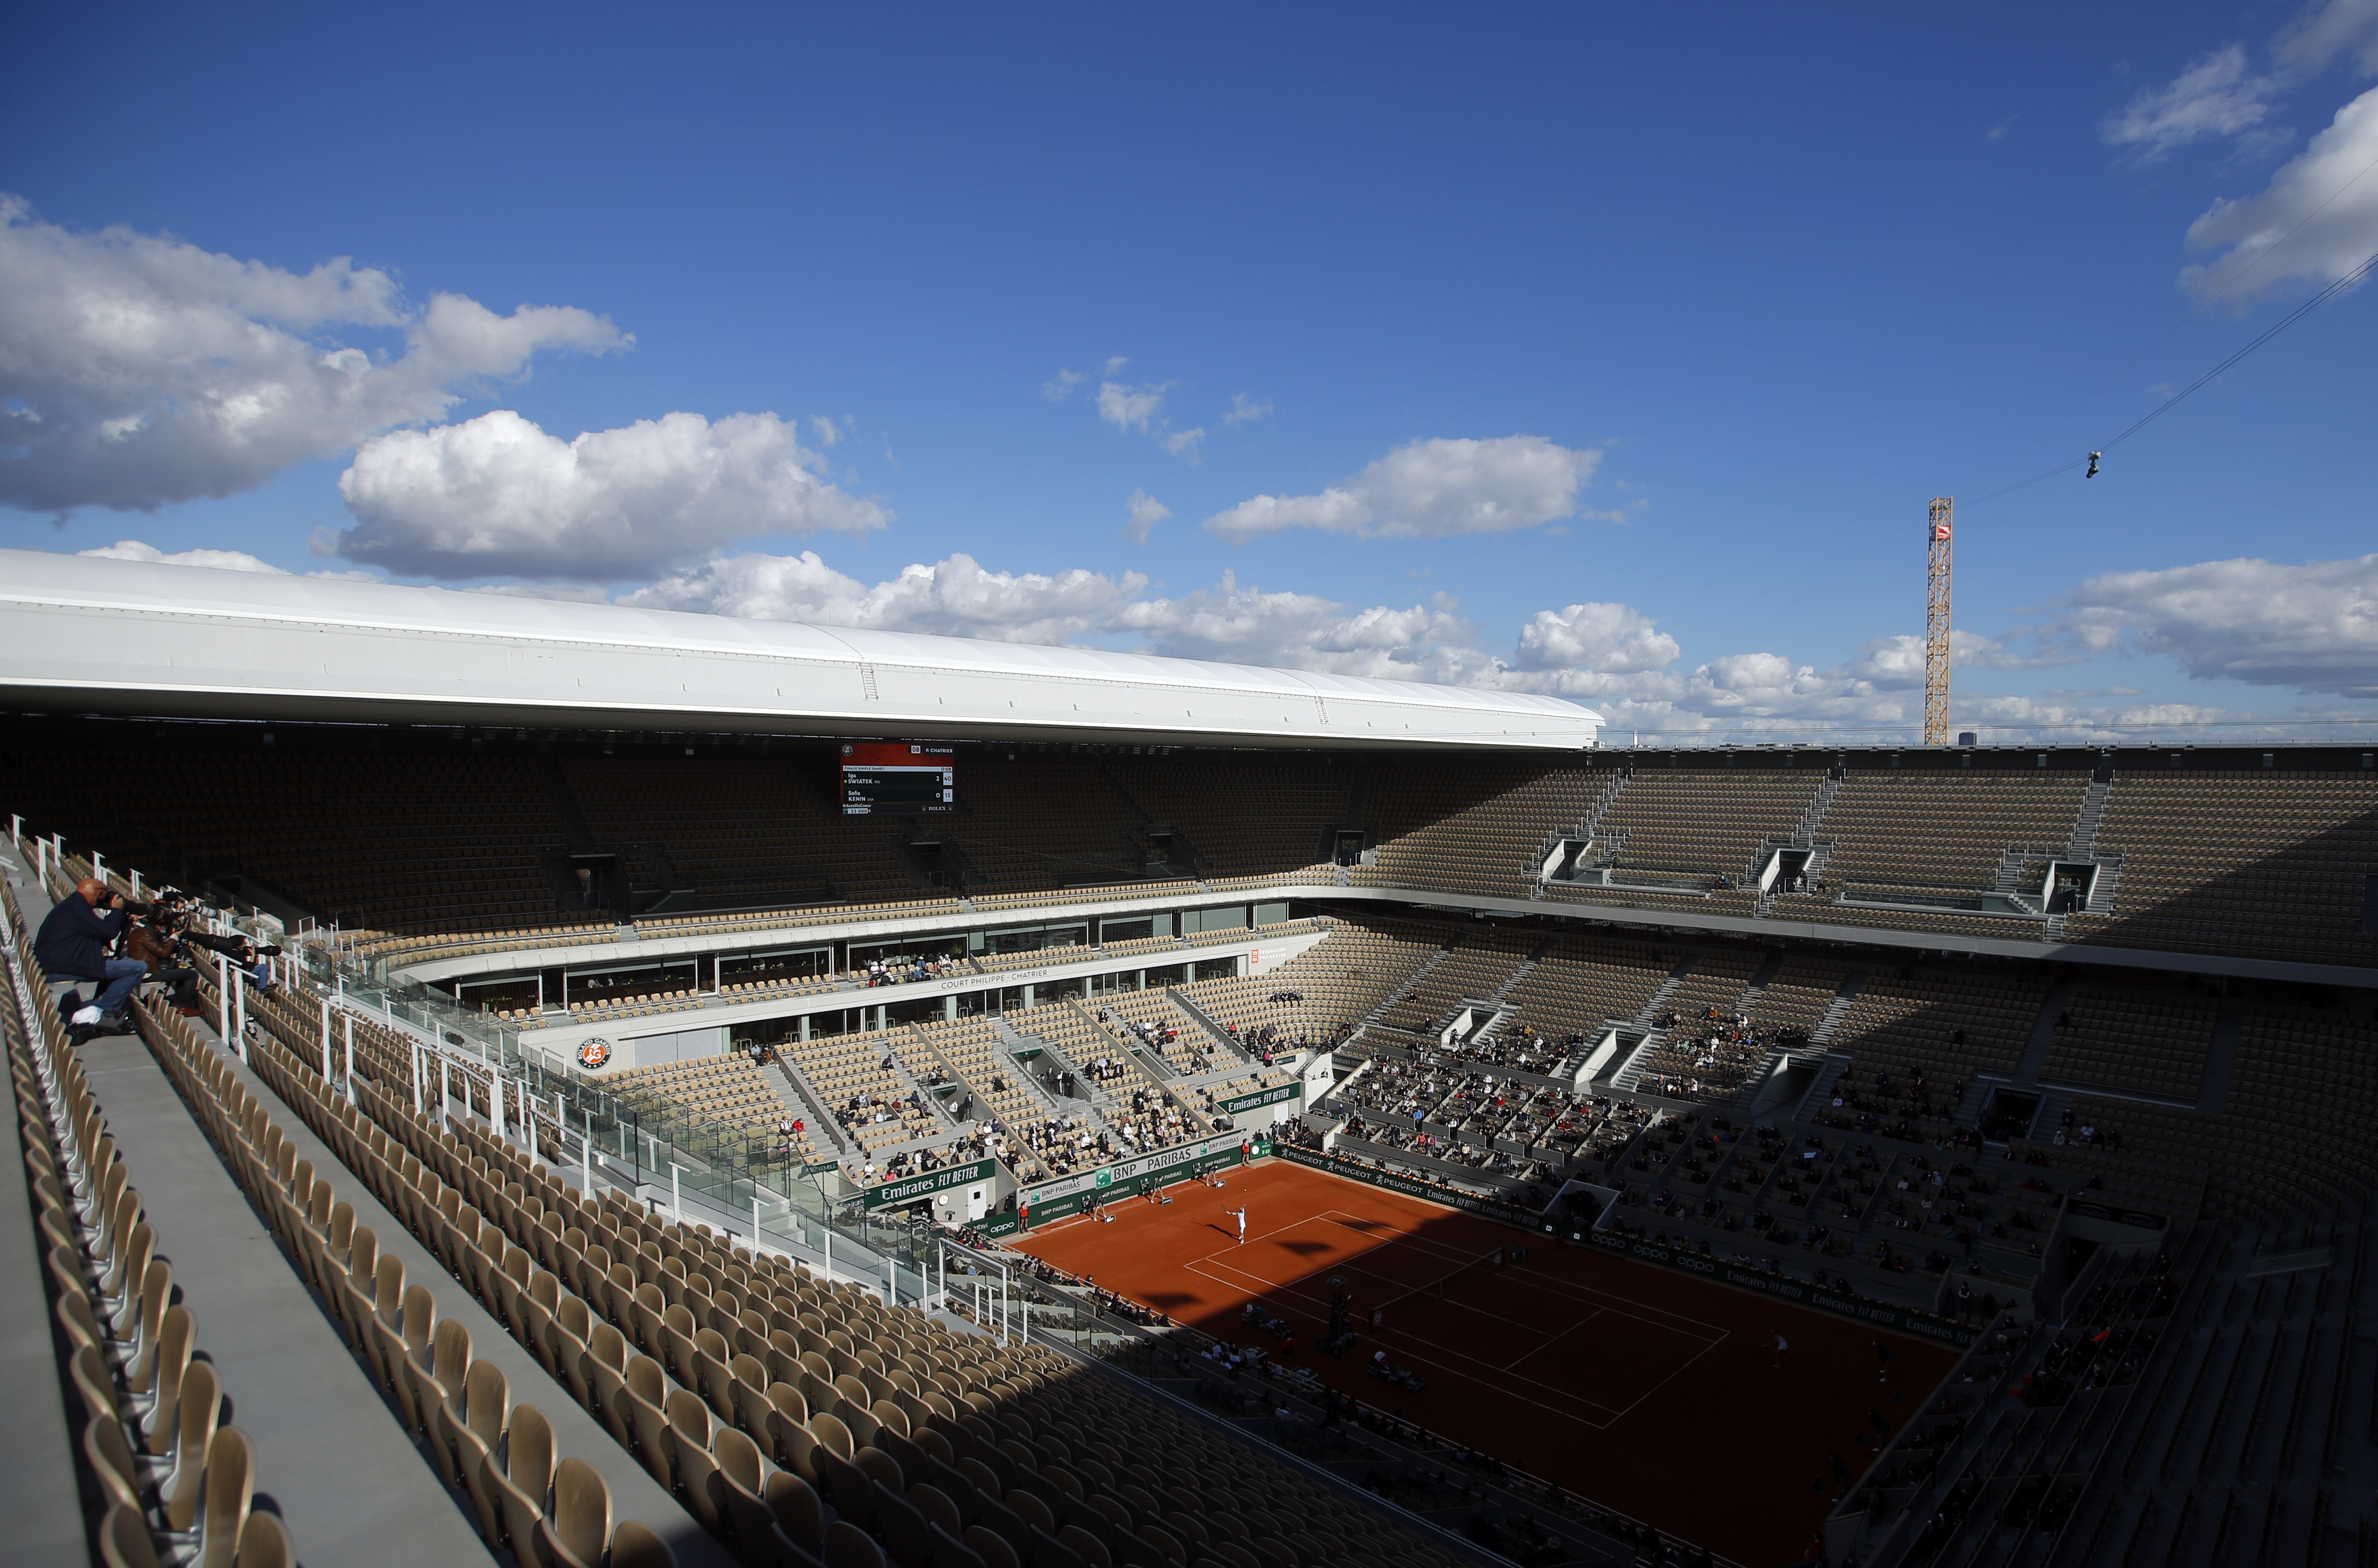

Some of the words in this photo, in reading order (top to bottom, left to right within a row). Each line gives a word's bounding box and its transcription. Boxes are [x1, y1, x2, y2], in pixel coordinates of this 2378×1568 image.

[941, 980, 968, 989] COURT
[971, 975, 1005, 986] PHILIPPE
[1011, 970, 1048, 980] CHATRIER
[578, 1039, 593, 1060] ROLAND
[594, 1039, 611, 1055] GARROS
[1228, 1097, 1261, 1113] Emirates
[1263, 1092, 1272, 1104] FLY
[1273, 1088, 1290, 1101] BETTER
[1209, 1142, 1219, 1150] BNP
[1219, 1136, 1239, 1147] PARIBAS
[1114, 1164, 1136, 1180] BNP
[1147, 1148, 1192, 1170] PARIBAS
[1214, 1156, 1230, 1166] PARIBAS
[1288, 1151, 1323, 1165] PEUGEOT
[1154, 1174, 1164, 1182] BP
[1164, 1170, 1182, 1179] PARIBAS
[1334, 1164, 1372, 1179] PEUGEOT
[881, 1179, 934, 1200] Emirates
[938, 1171, 951, 1187] FLY
[952, 1166, 978, 1183] BETTER
[1042, 1188, 1054, 1197] BNP
[1056, 1181, 1080, 1193] PARIBAS
[1384, 1178, 1423, 1193] PEUGEOT
[1111, 1186, 1130, 1196] PARIBAS
[1427, 1189, 1455, 1204] Emirates
[1456, 1197, 1464, 1206] FLY
[1464, 1198, 1481, 1211] BETTER
[1041, 1208, 1052, 1216] BNP
[1053, 1202, 1073, 1213] PARIBAS
[1482, 1204, 1512, 1219] Emirates
[1514, 1213, 1522, 1222] FLY
[1522, 1215, 1539, 1227] BETTER
[990, 1221, 1014, 1233] oppo
[1592, 1233, 1625, 1248] oppo
[1633, 1245, 1669, 1260] oppo
[1677, 1257, 1714, 1272] oppo
[1727, 1271, 1765, 1289] Emirates
[1768, 1282, 1780, 1293] FLY
[1780, 1284, 1803, 1299] BETTER
[1813, 1293, 1855, 1313] Emirates
[1858, 1306, 1870, 1317] FLY
[1870, 1309, 1895, 1324] BETTER
[1906, 1318, 1953, 1339] Emirates
[1957, 1332, 1969, 1343] FLY
